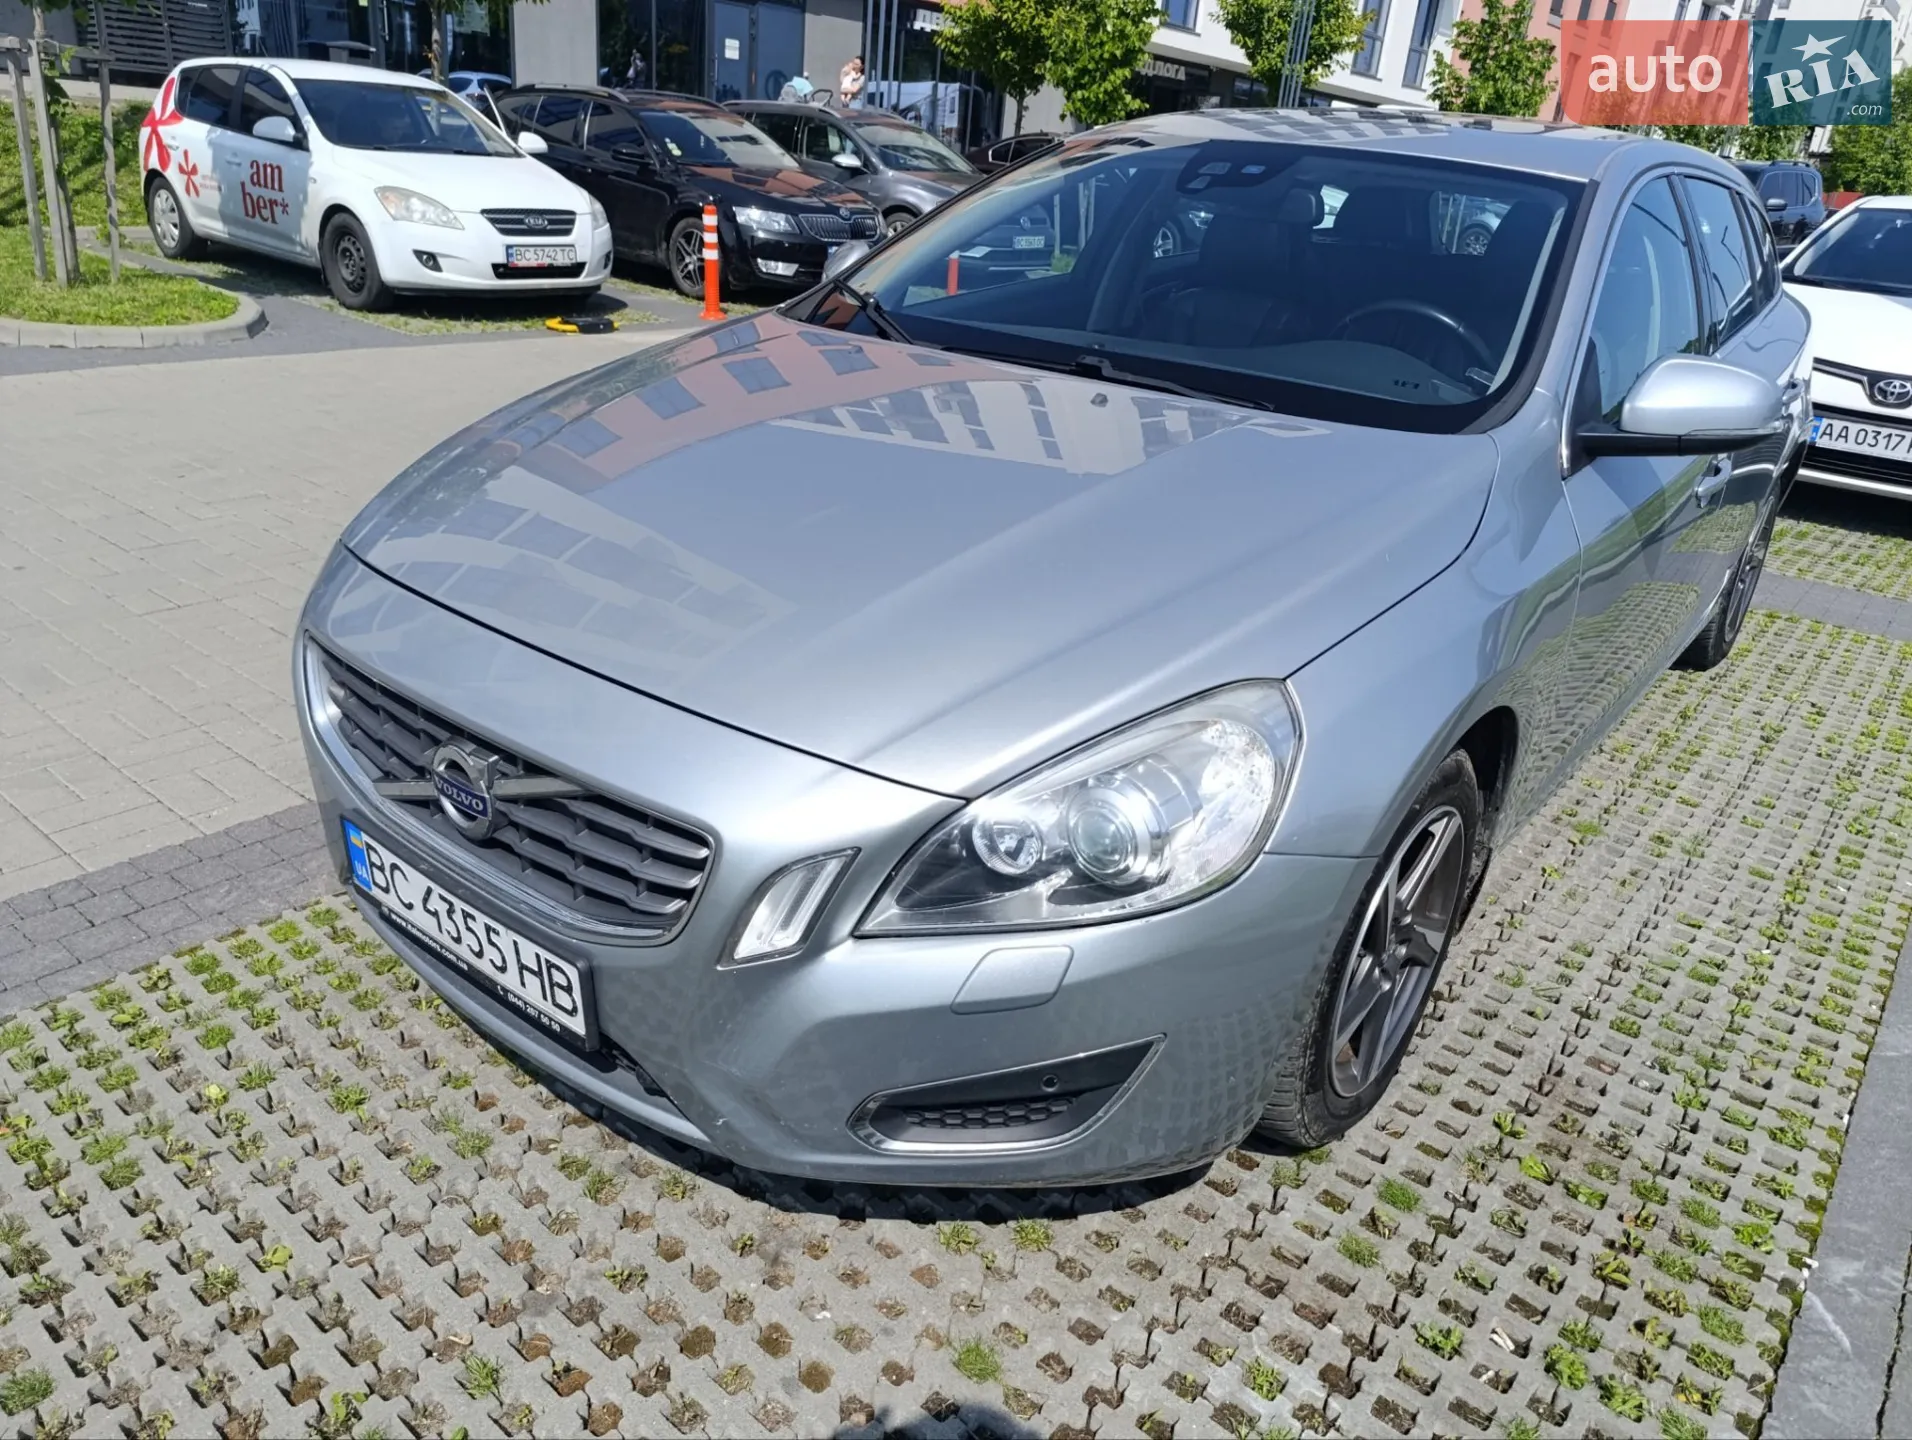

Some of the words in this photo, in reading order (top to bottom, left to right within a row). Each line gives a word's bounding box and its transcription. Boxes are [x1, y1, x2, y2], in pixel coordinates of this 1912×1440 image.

[249, 159, 285, 193] am
[515, 249, 531, 262] BC
[533, 248, 558, 262] 5742
[560, 249, 575, 261] TC
[1819, 422, 1849, 443] AA
[1854, 428, 1906, 452] 0317
[434, 774, 484, 811] VOLVO
[355, 860, 369, 881] UA
[364, 840, 414, 911] BC
[421, 885, 508, 974] 4355
[513, 938, 578, 1018] HB
[507, 992, 526, 1011] (044)
